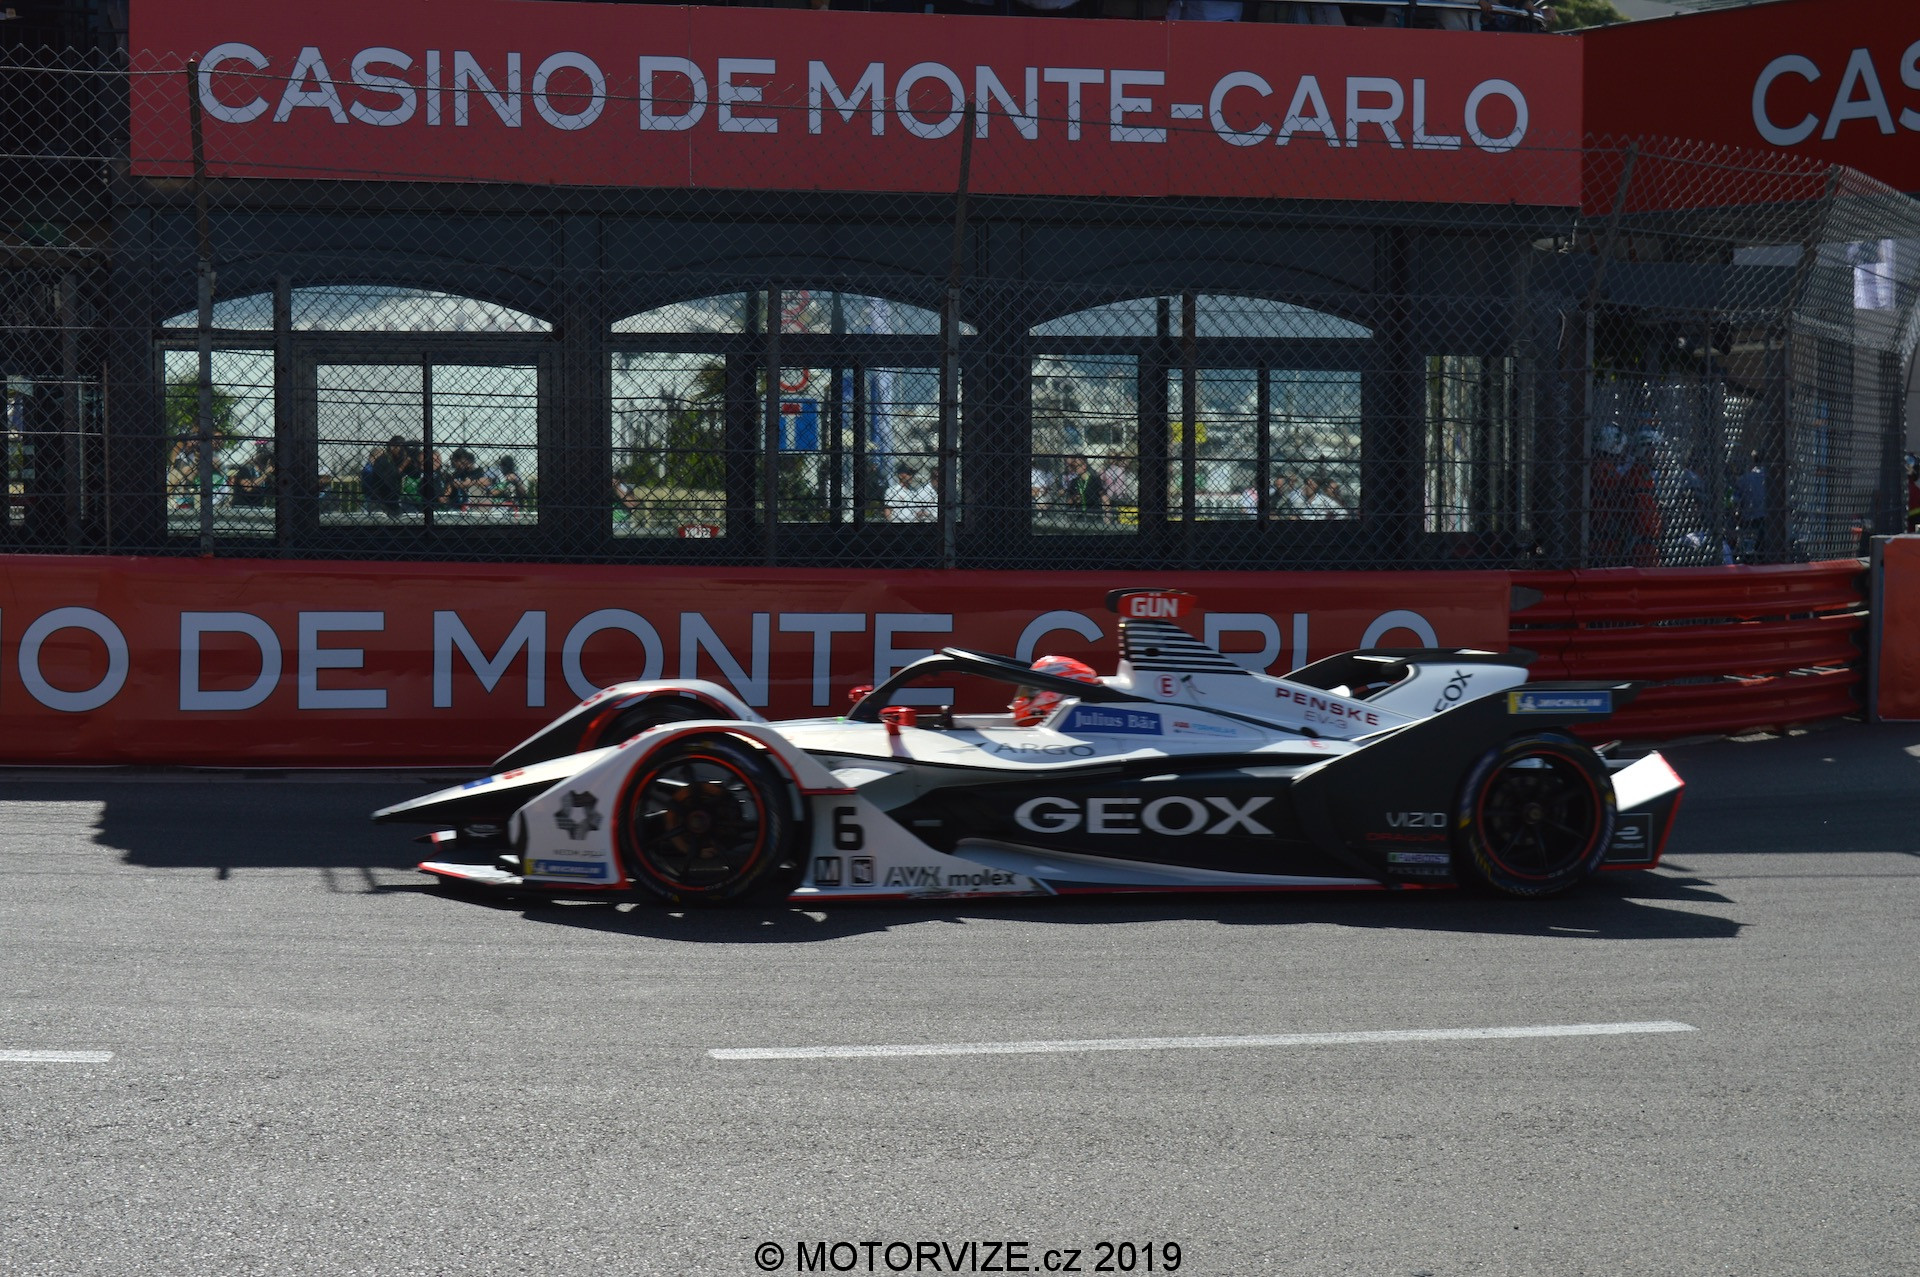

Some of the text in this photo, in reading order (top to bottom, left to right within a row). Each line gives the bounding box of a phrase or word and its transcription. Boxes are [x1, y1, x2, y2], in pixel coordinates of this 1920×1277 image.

[196, 42, 1529, 154] CASINO DE MONTE-CARLO
[1131, 592, 1178, 617] GÜN
[0, 606, 129, 711] O
[179, 611, 388, 711] DE
[433, 608, 955, 709] MONTE
[1074, 711, 1124, 728] Julius
[1127, 713, 1158, 730] Bär
[1275, 687, 1380, 726] PENSKE
[993, 742, 1097, 757] ARGO
[833, 806, 865, 850] 6
[1014, 796, 1273, 836] GEOX
[1385, 811, 1448, 828] VIZIO
[946, 868, 1016, 886] molex
